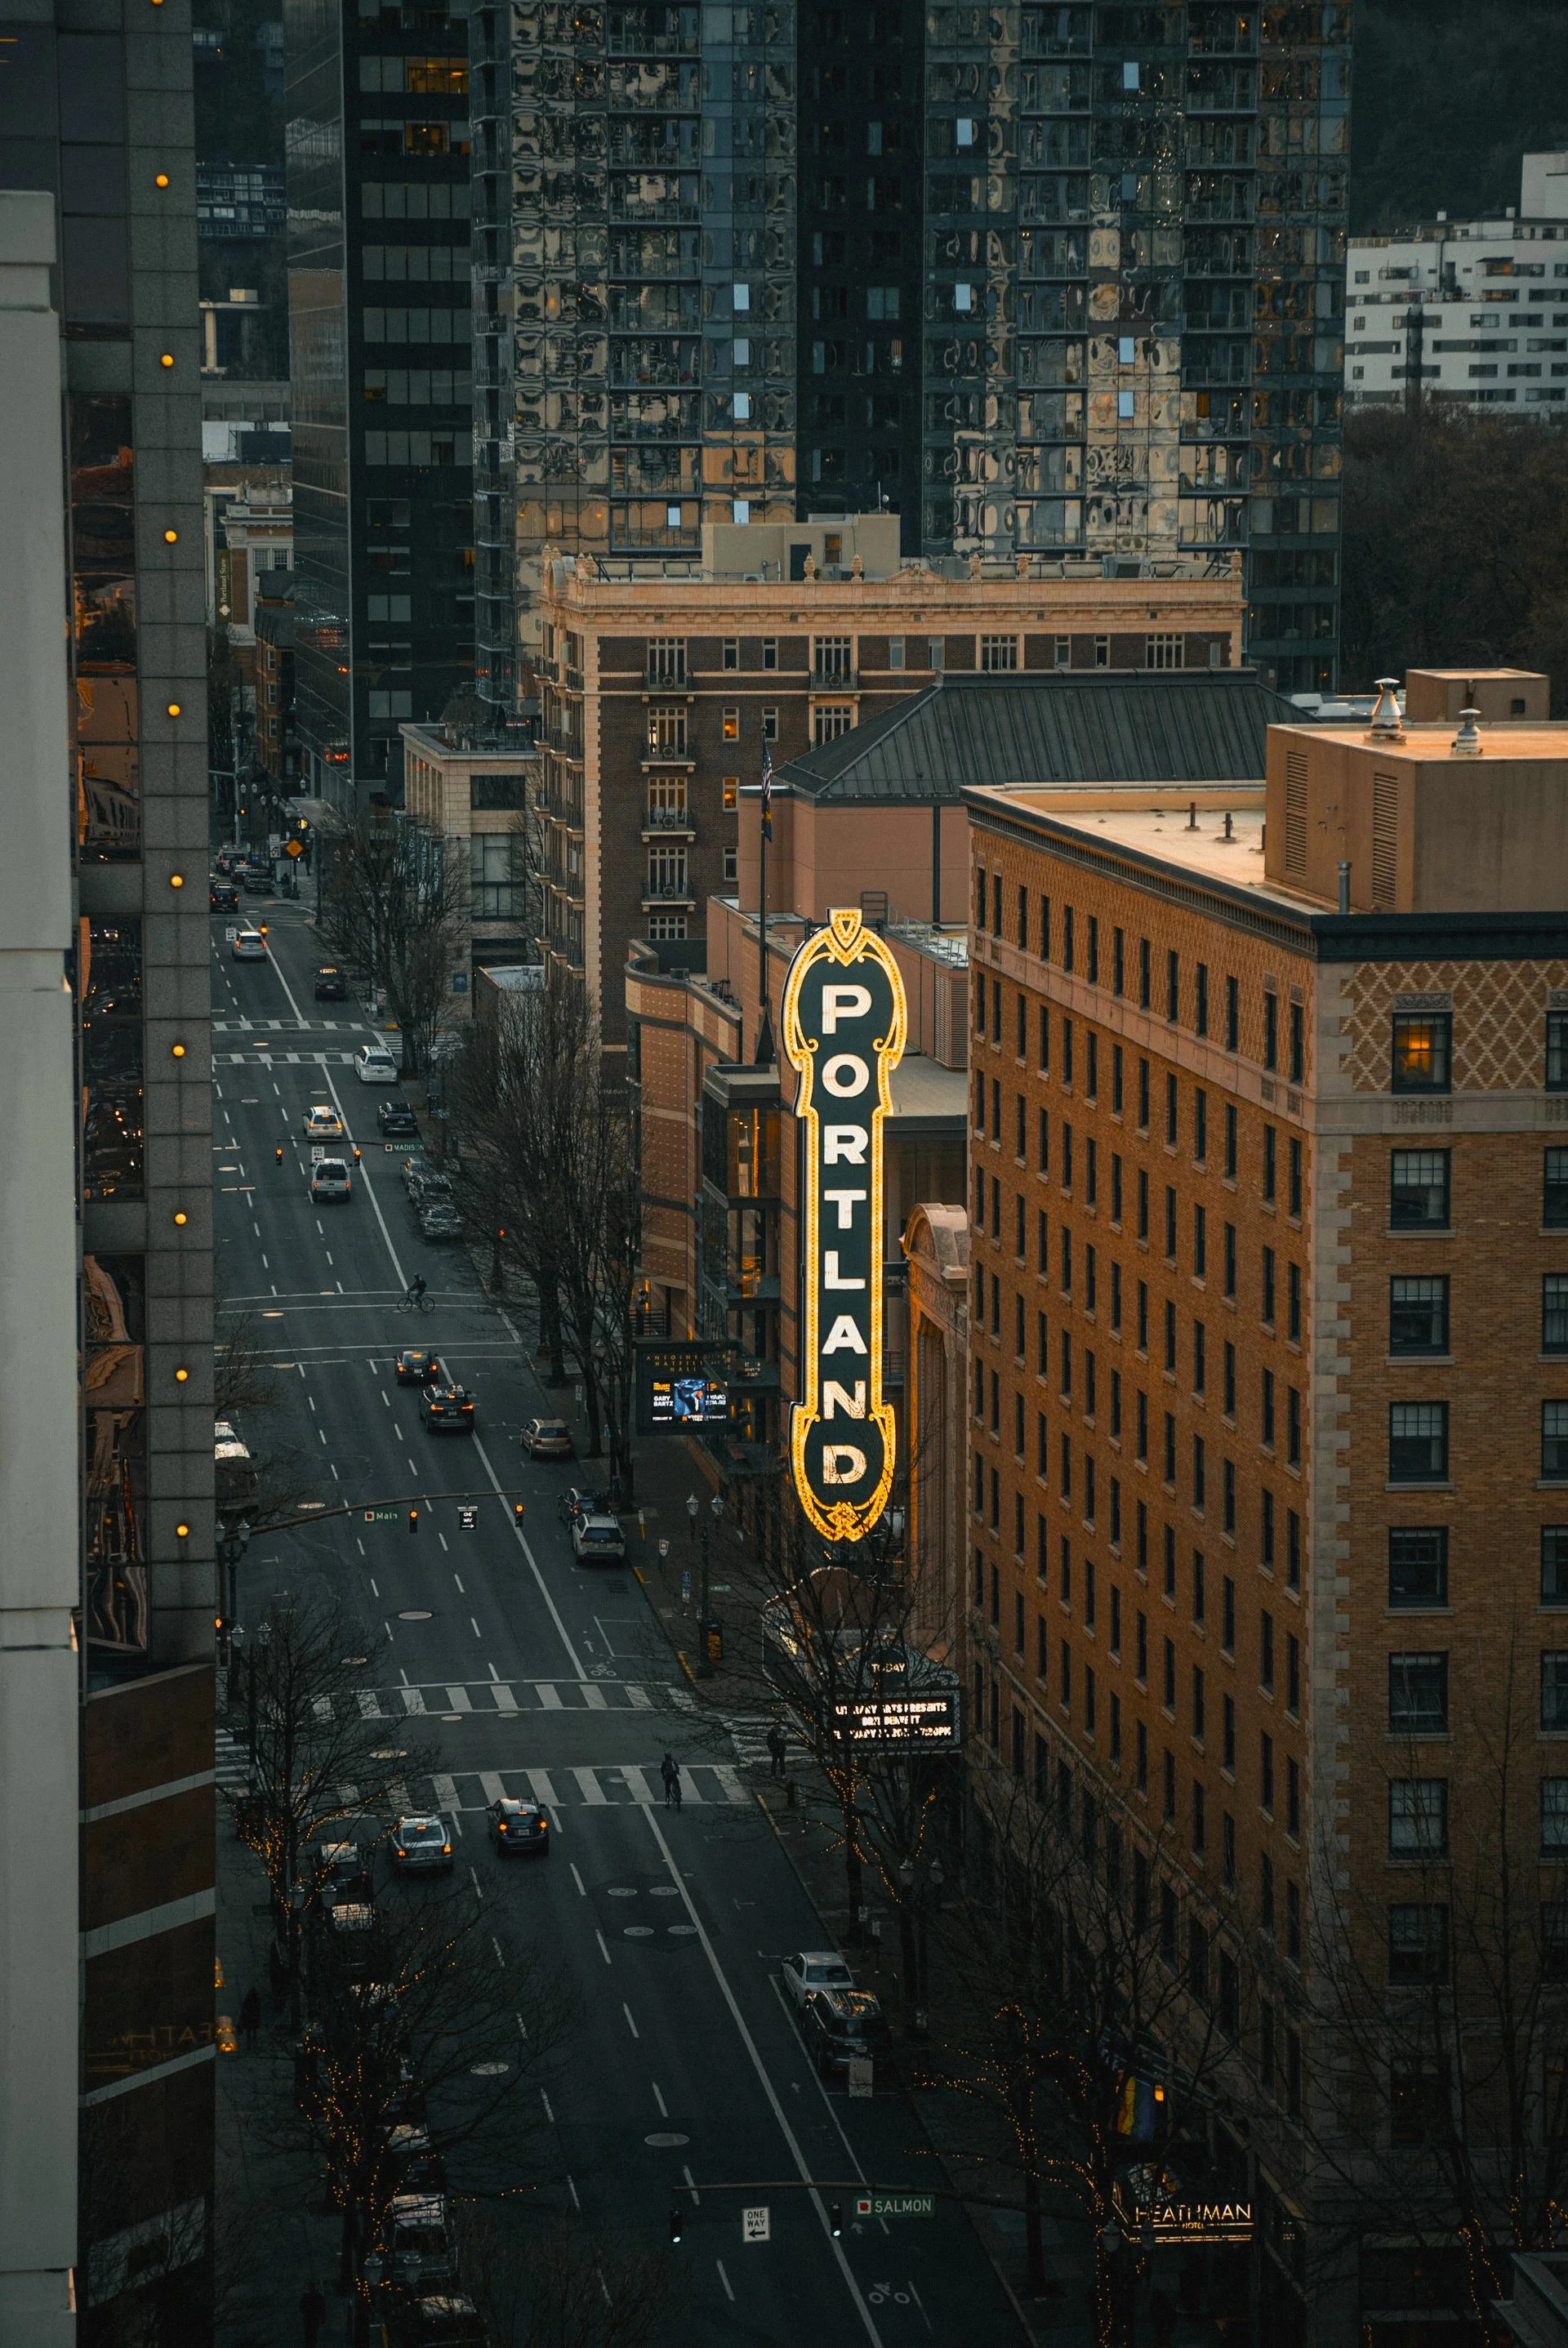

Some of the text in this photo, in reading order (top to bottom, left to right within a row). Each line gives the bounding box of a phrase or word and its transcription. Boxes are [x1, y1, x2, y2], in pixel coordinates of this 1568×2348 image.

[821, 983, 872, 1485] PORTLAND
[376, 1512, 398, 1520] Main
[835, 1705, 878, 1715] LITRY
[875, 2199, 932, 2213] SALMON
[747, 2210, 764, 2220] ONE
[1135, 2203, 1251, 2222] HEATHMAN
[747, 2219, 765, 2228] WAY
